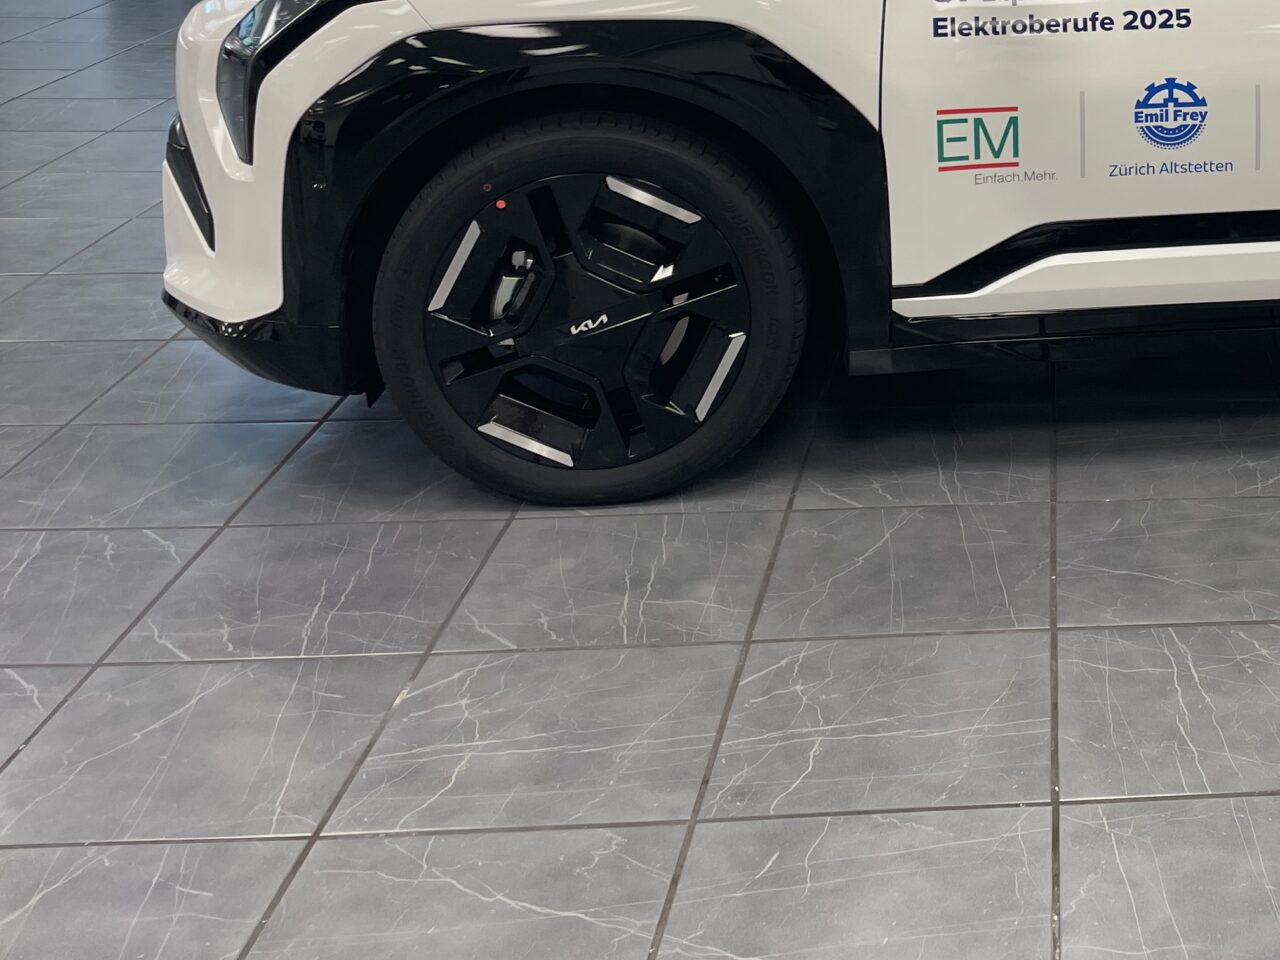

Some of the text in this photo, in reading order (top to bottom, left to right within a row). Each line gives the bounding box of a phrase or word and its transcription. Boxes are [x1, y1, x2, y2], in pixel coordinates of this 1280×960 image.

[932, 8, 1193, 38] Elektroberufe 2025
[1134, 109, 1208, 123] Emil Frey
[936, 115, 1020, 163] EM
[1108, 160, 1233, 177] Zürich Altstetten
[974, 170, 1059, 185] Einfach.Mehr.
